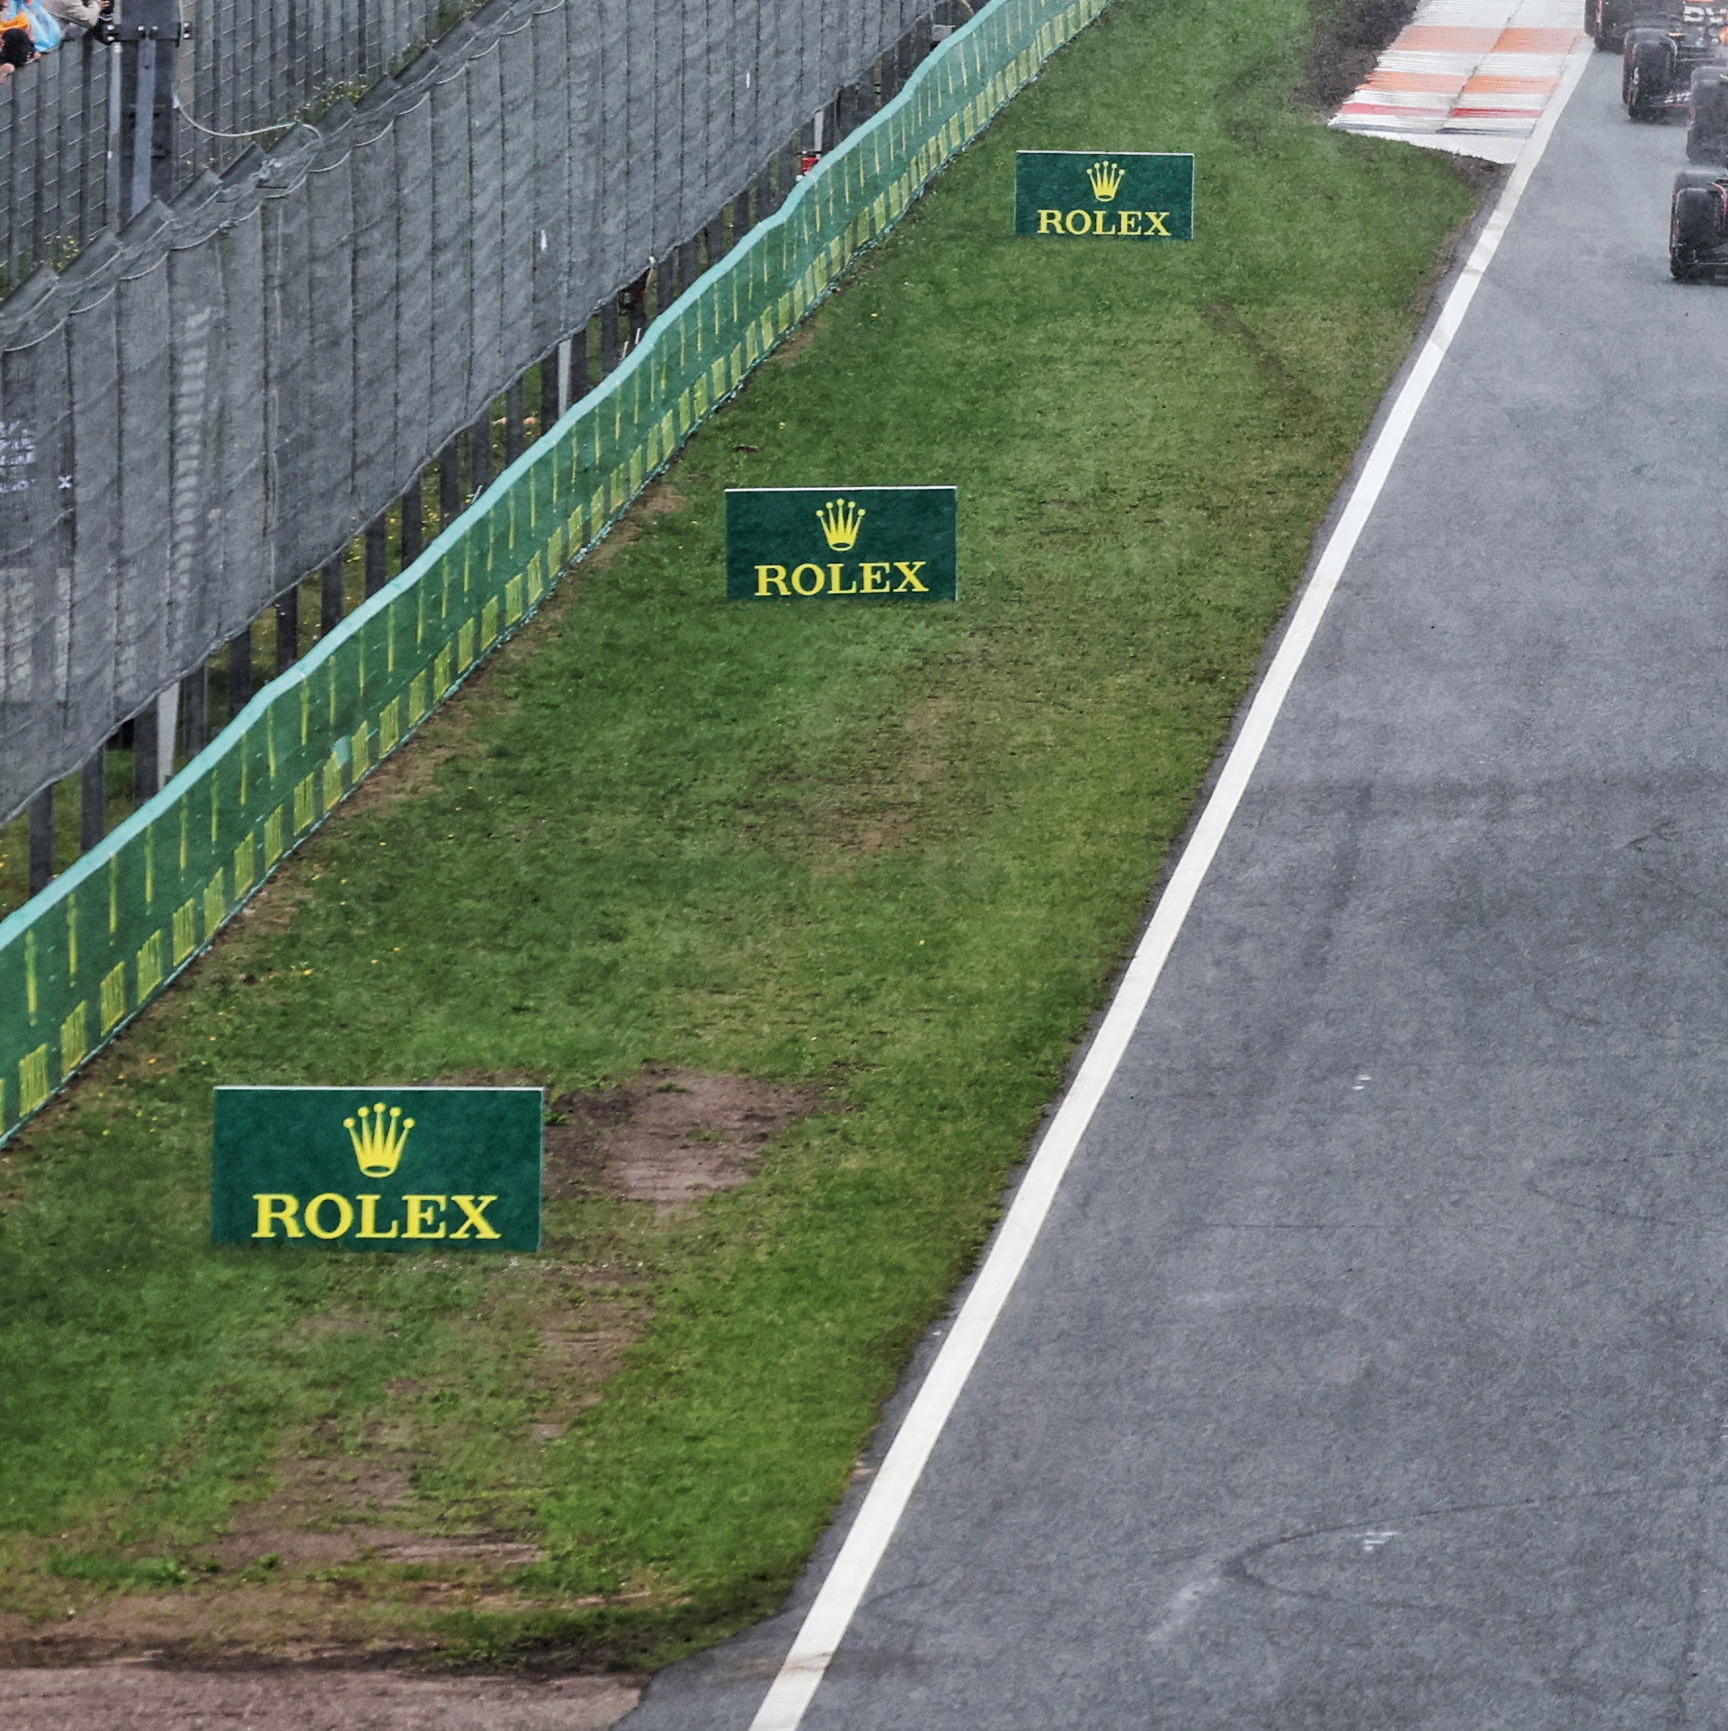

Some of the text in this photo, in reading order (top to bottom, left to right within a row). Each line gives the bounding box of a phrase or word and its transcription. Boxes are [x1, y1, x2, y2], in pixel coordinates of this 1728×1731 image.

[1039, 209, 1170, 237] ROLEX
[755, 561, 929, 596] ROLEX
[252, 1192, 500, 1240] ROLEX
